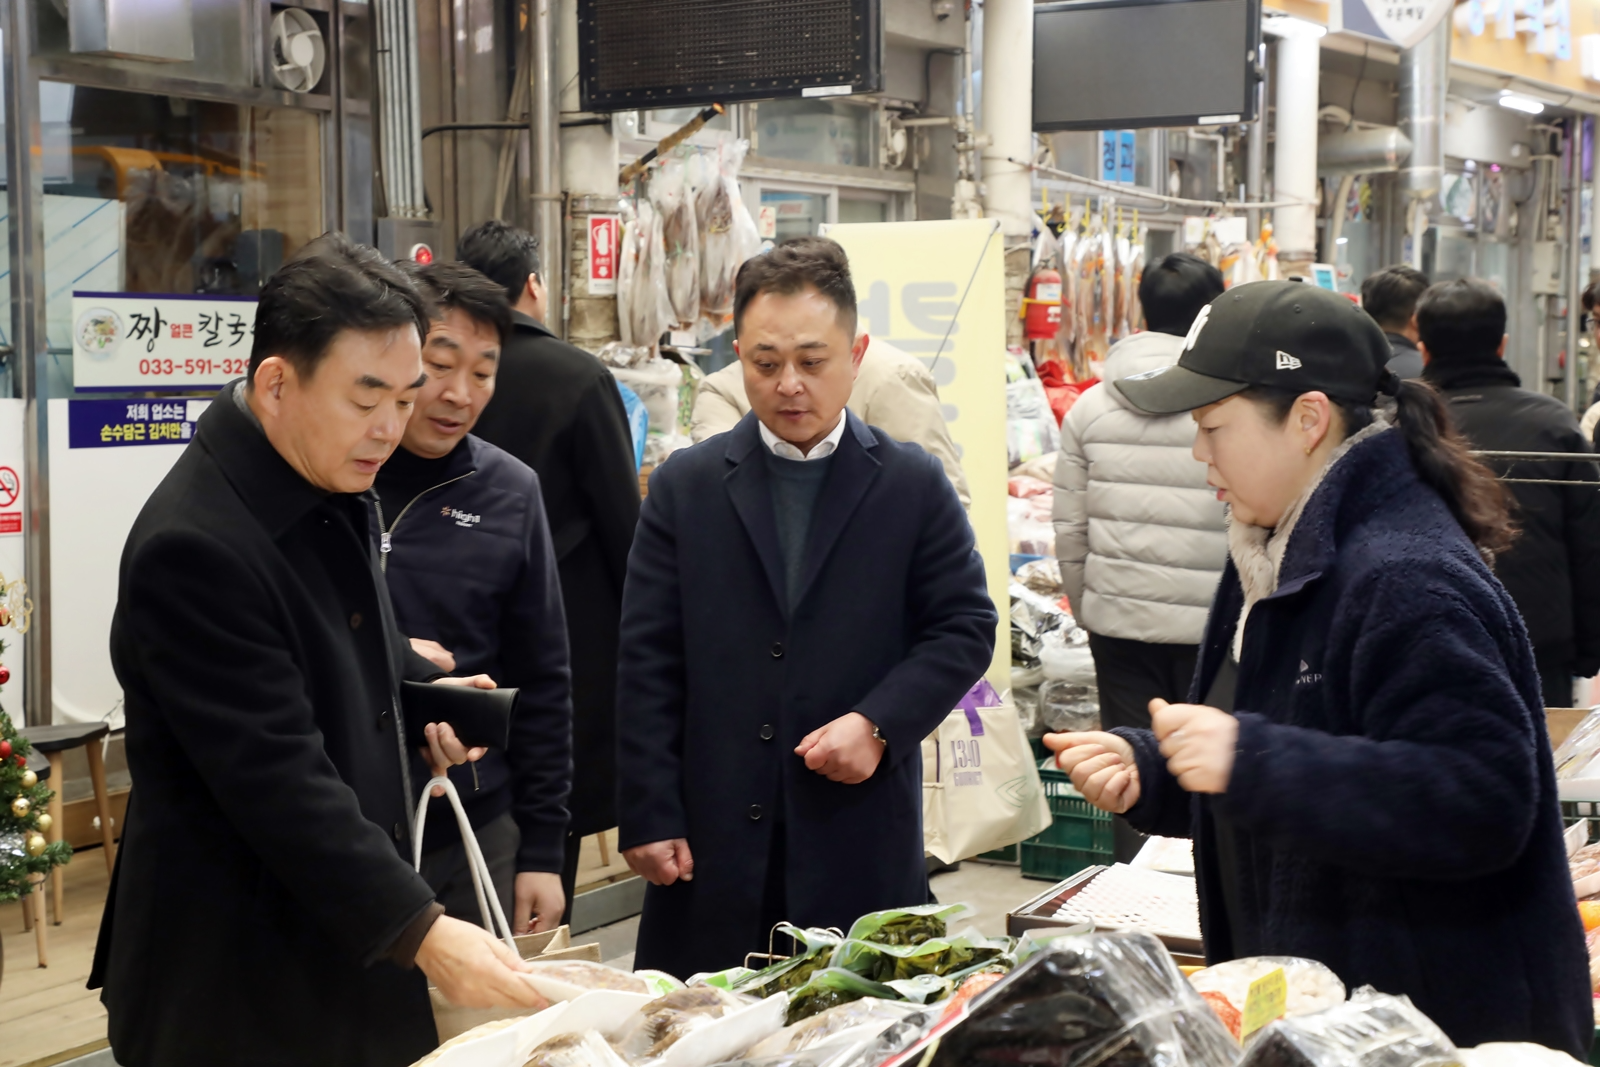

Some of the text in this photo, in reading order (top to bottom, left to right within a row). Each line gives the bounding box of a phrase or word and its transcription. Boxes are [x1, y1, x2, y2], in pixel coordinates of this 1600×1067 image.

[126, 306, 256, 353] 짱 얼큰 칼국
[126, 403, 184, 421] 저희 업소는
[100, 422, 192, 442] 손수담근 김치만을
